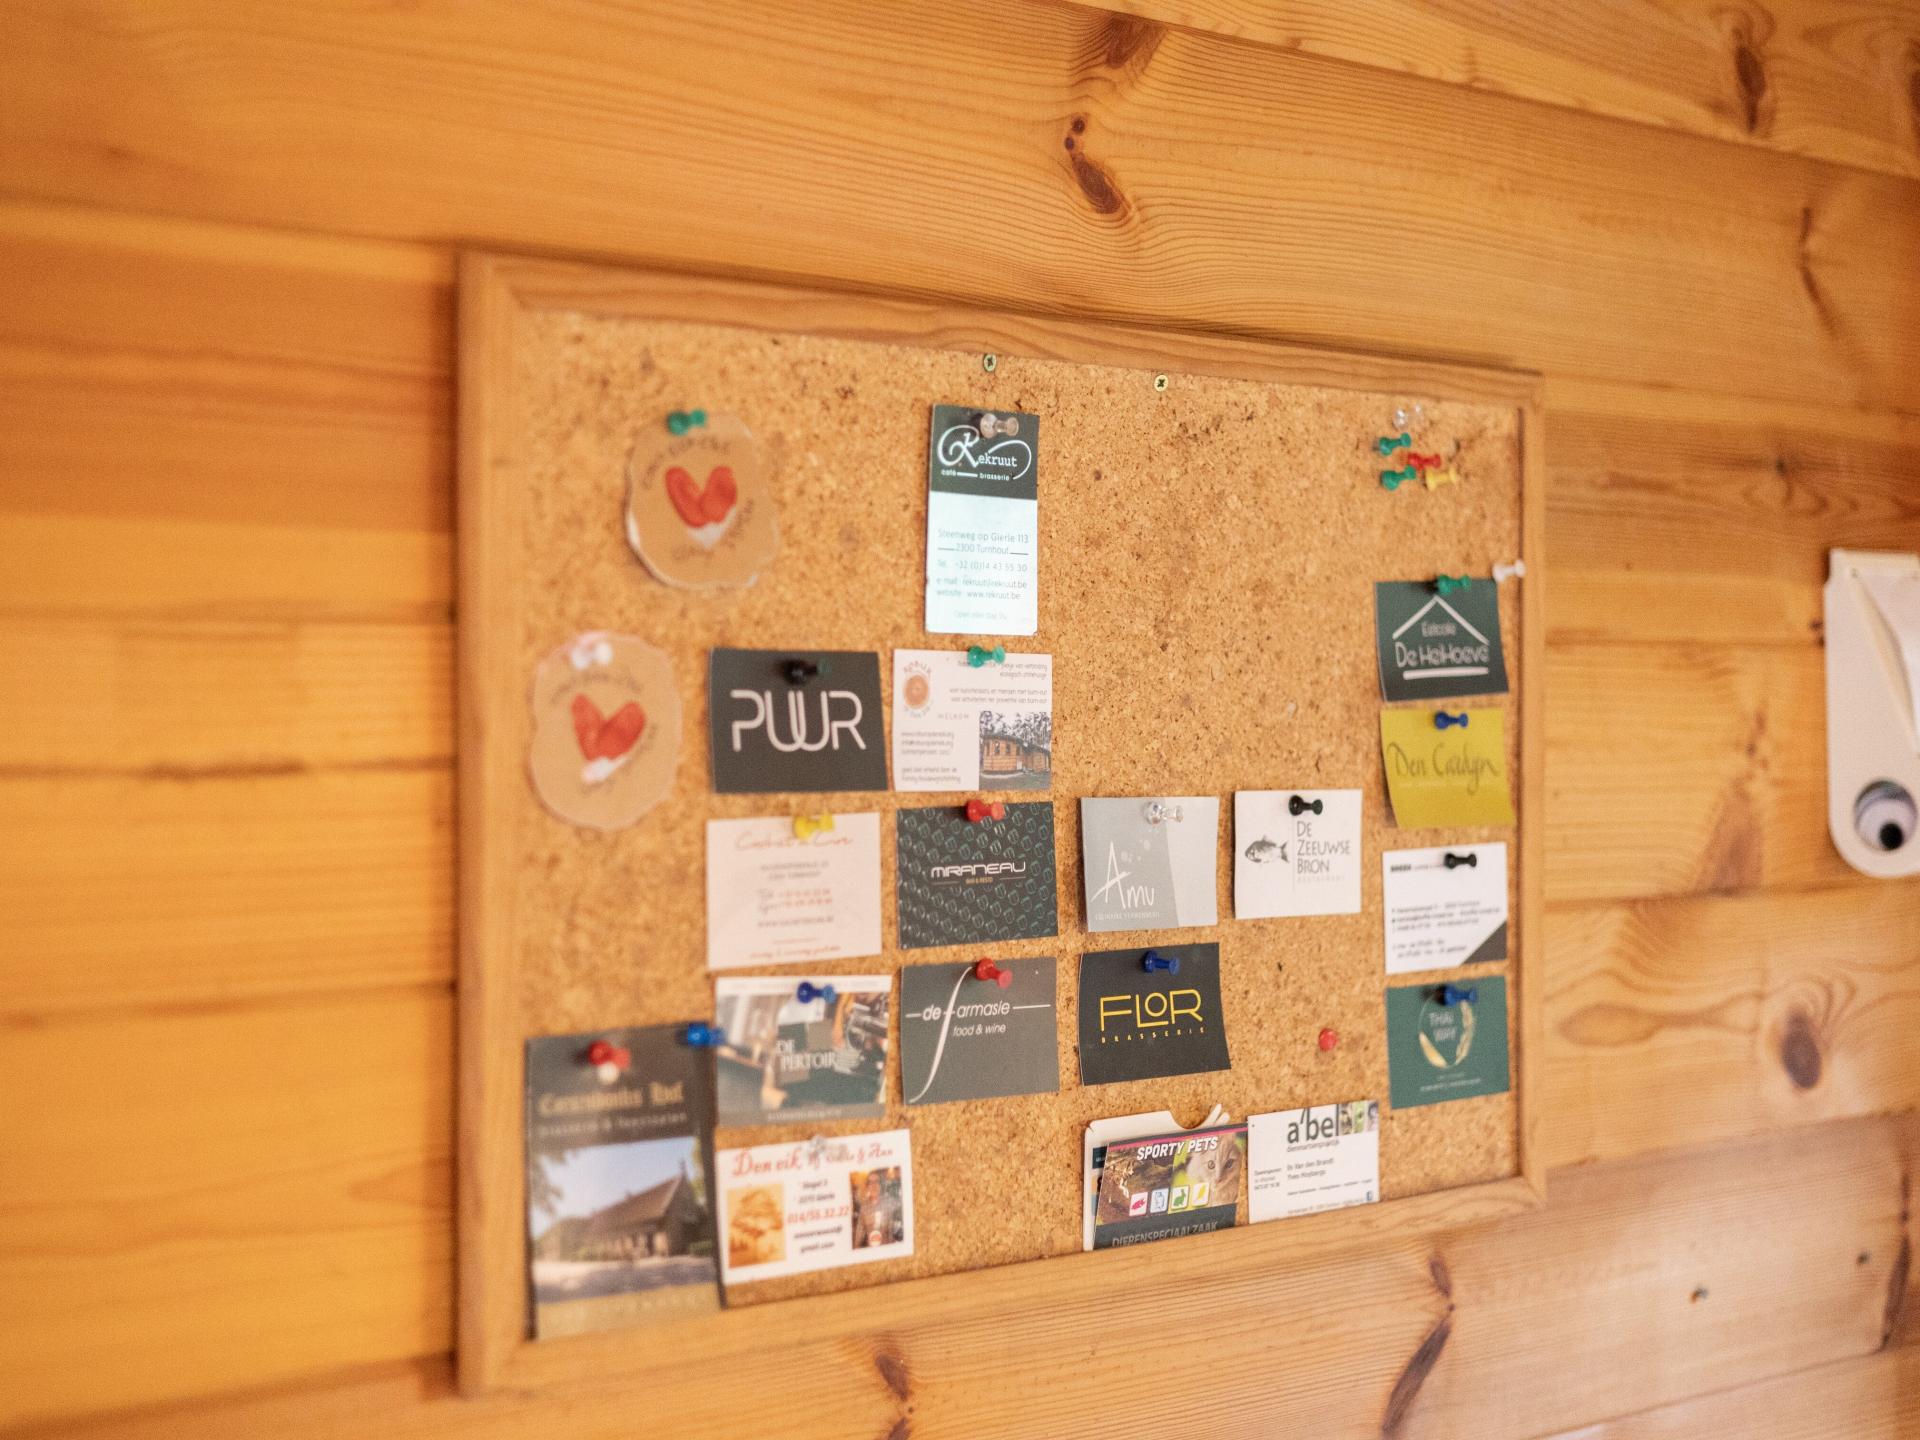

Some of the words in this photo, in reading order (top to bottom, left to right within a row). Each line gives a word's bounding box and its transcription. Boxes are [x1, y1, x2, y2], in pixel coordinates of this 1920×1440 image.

[937, 424, 1020, 468] Rekruut
[976, 544, 1009, 555] Turnhout
[1395, 641, 1417, 668] De
[730, 689, 866, 752] PUUR
[1297, 821, 1312, 837] DE
[1297, 839, 1351, 856] ZEEUWSE
[931, 861, 1026, 878] MIRANEAU
[1297, 858, 1330, 874] BRON
[922, 1003, 942, 1021] de
[1100, 989, 1203, 1032] FLOR
[953, 1024, 974, 1036] food
[976, 1024, 982, 1034] &
[985, 1023, 1007, 1034] wine
[1101, 1027, 1205, 1044] BRASSERIE
[1136, 1143, 1184, 1161] SPORTY
[1187, 1137, 1219, 1152] PETS
